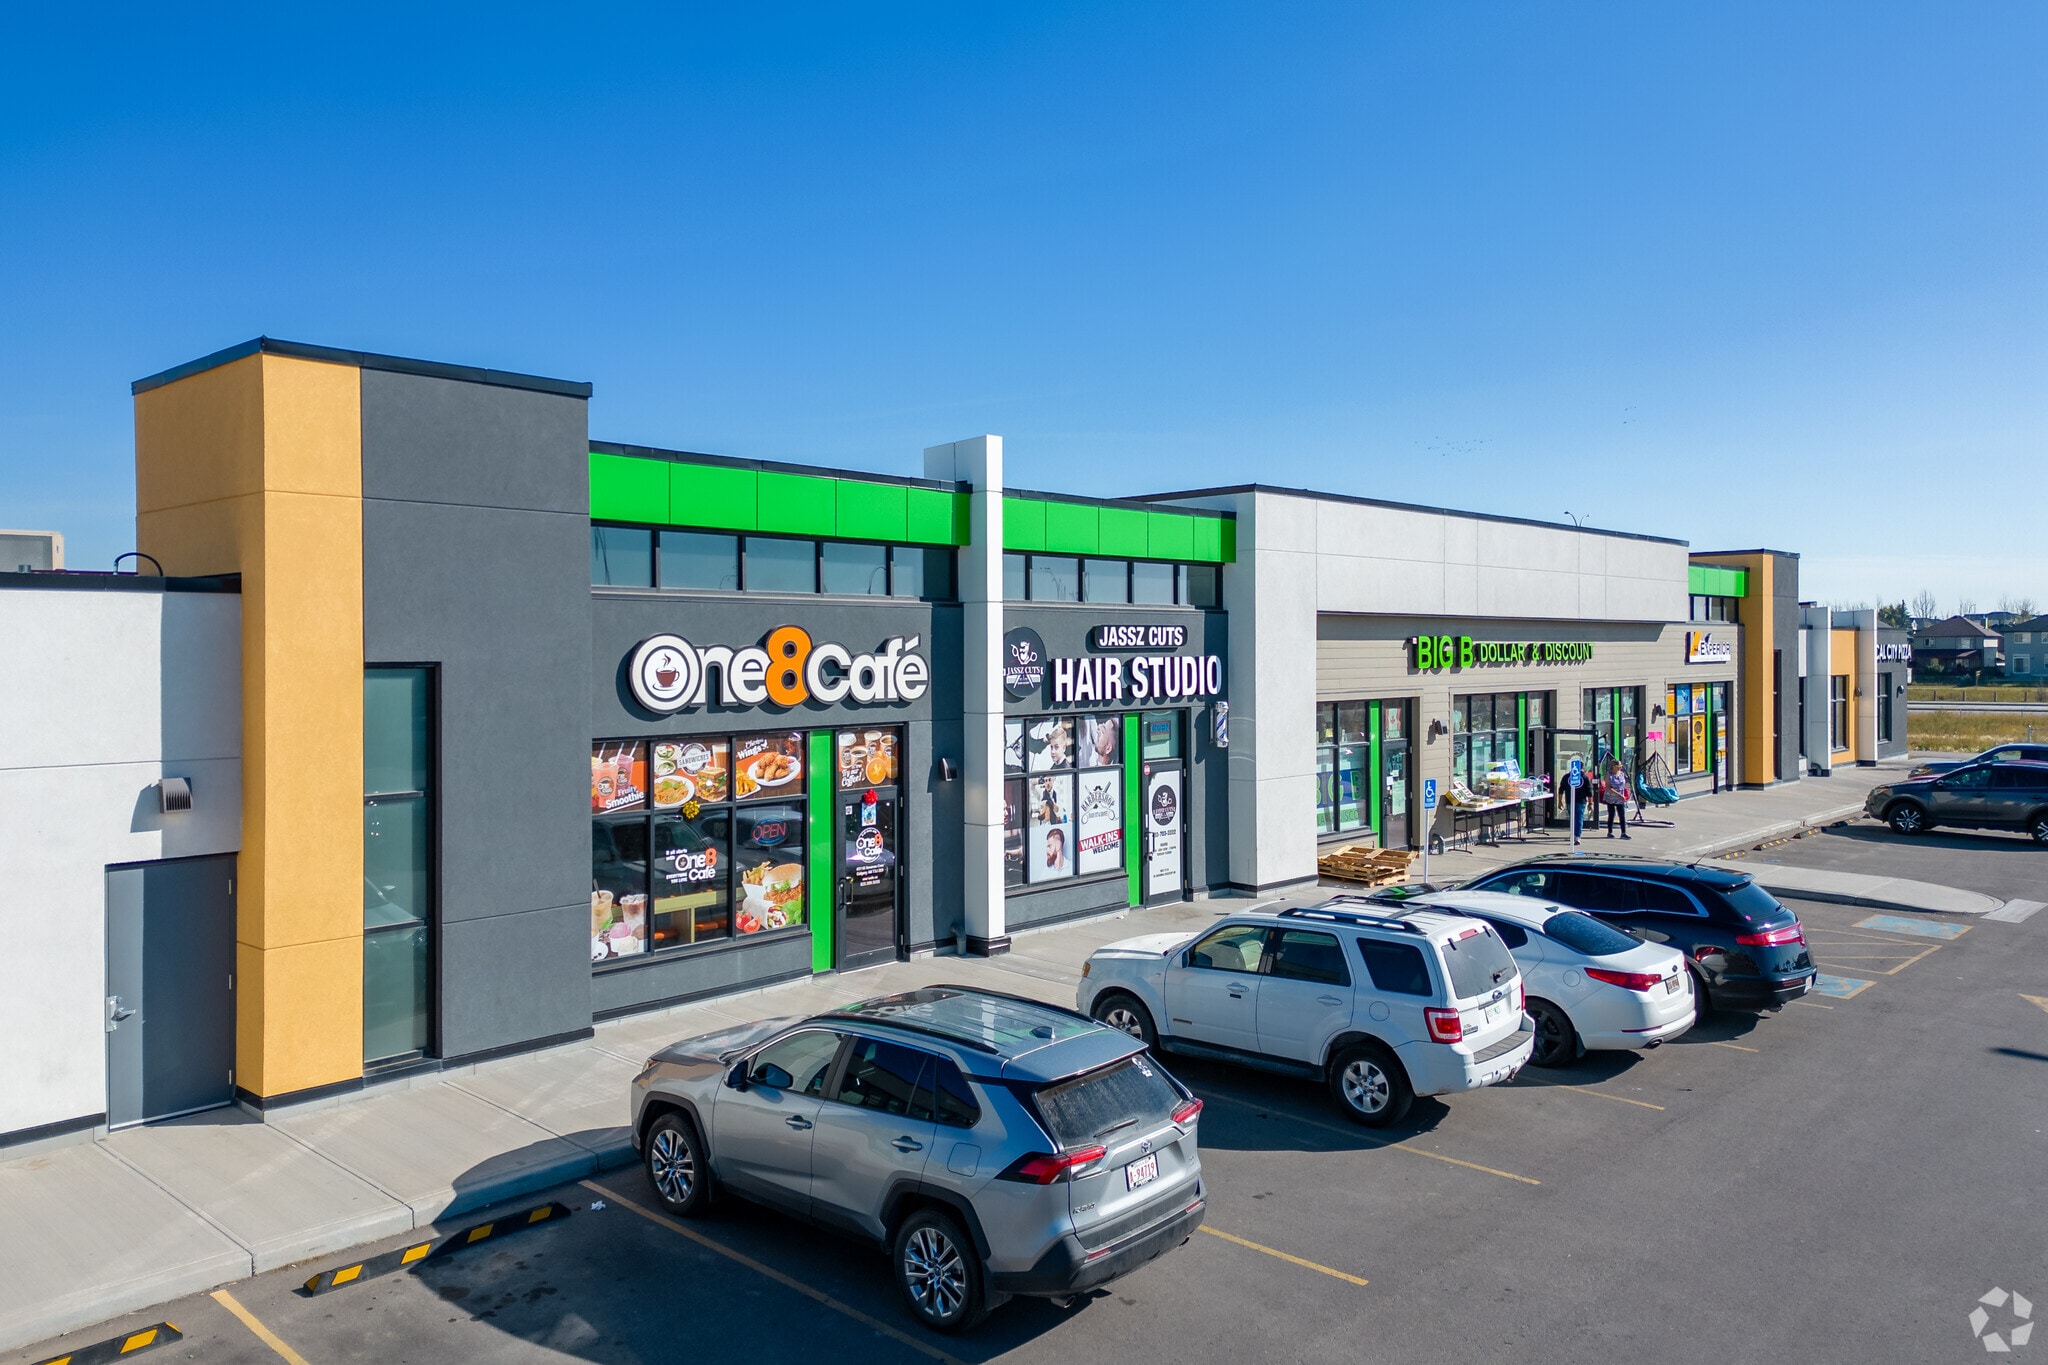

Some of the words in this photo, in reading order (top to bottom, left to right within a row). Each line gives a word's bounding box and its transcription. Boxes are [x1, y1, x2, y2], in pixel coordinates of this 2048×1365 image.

[1099, 626, 1145, 646] JASSZ
[1149, 626, 1183, 646] CUTS
[1418, 635, 1453, 669] BIG
[1460, 635, 1474, 668] B
[1480, 643, 1526, 662] DOLLAR
[1532, 643, 1540, 660] &
[1545, 642, 1595, 660] DISCOUNT
[1025, 666, 1041, 674] CUTS
[1055, 656, 1122, 702] HAIR
[1131, 655, 1222, 699] STUDIO
[605, 791, 645, 809] Smoothie
[1081, 791, 1116, 812] BARBERSHOP
[752, 822, 787, 841] OPEN
[1080, 829, 1119, 851] WALK-INS
[1092, 841, 1120, 854] WELCOME
[675, 847, 717, 871] One8
[689, 865, 716, 880] Café
